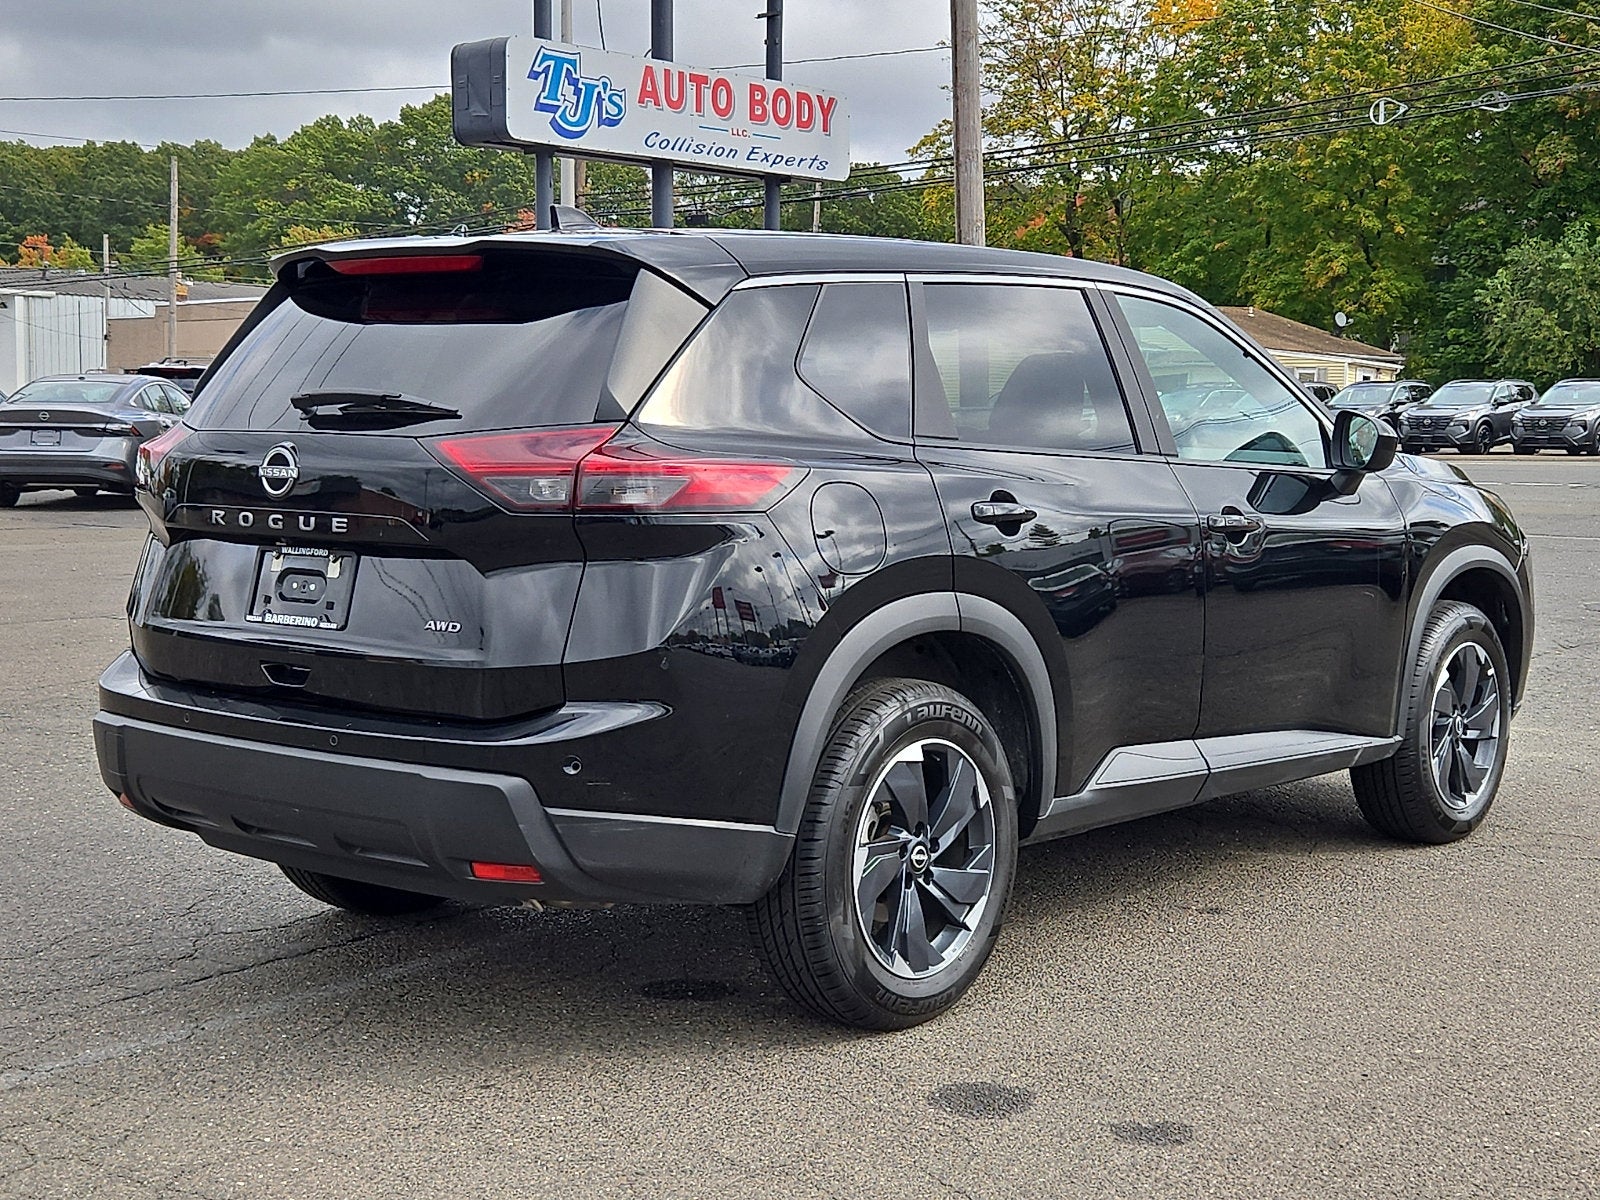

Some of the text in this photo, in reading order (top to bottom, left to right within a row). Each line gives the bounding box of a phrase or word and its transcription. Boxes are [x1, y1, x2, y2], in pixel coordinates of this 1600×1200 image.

[638, 65, 837, 134] AUTO BODY
[644, 132, 829, 171] Collision Experts
[259, 467, 298, 477] NISSAN
[211, 510, 348, 533] ROGUE
[281, 547, 328, 556] WALLINGFORD
[264, 613, 318, 627] BARBERINO
[424, 620, 462, 632] AWD
